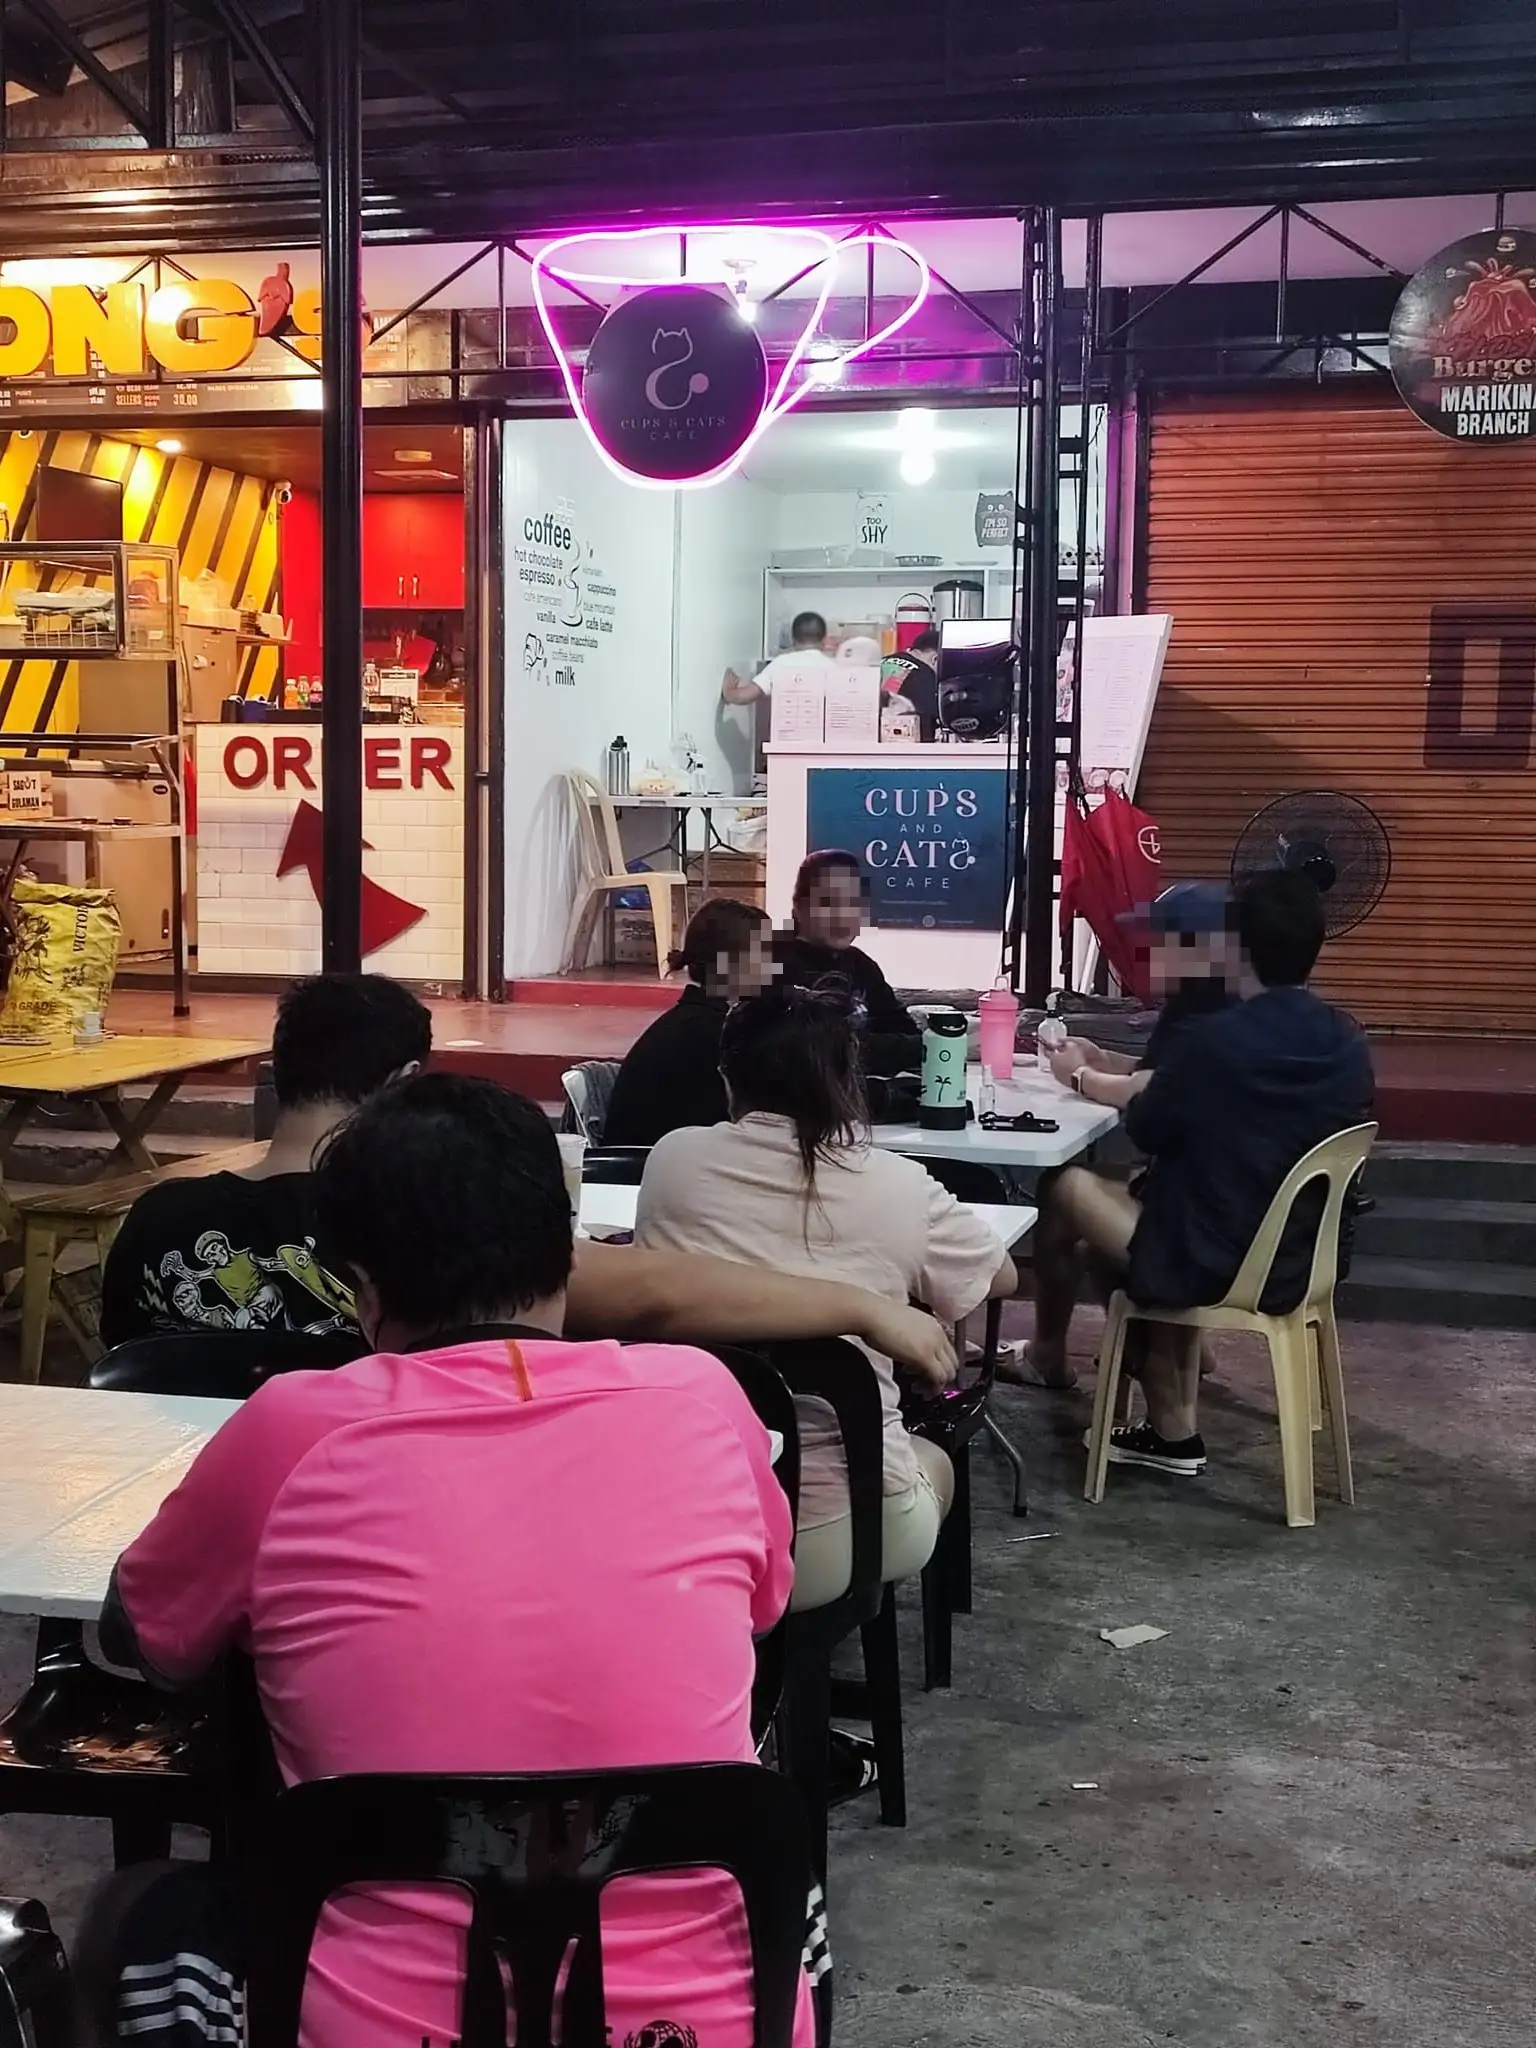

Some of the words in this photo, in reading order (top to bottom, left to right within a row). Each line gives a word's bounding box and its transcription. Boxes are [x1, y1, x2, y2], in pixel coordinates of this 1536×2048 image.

[1432, 356, 1536, 382] Burge
[621, 418, 660, 430] CUPS
[686, 416, 726, 428] CATS
[1457, 411, 1530, 436] BRANCH
[866, 516, 881, 525] TOO
[998, 517, 1008, 528] SO
[524, 513, 571, 550] coffee
[861, 525, 888, 544] SHY
[514, 547, 527, 563] hot
[528, 552, 563, 569] chocolate
[519, 568, 555, 585] espresso
[537, 610, 556, 623] vanilla
[555, 666, 575, 686] milk
[223, 736, 455, 790] ORER
[865, 787, 978, 817] CUPS
[900, 823, 942, 834] AND
[886, 876, 950, 889] CAFE
